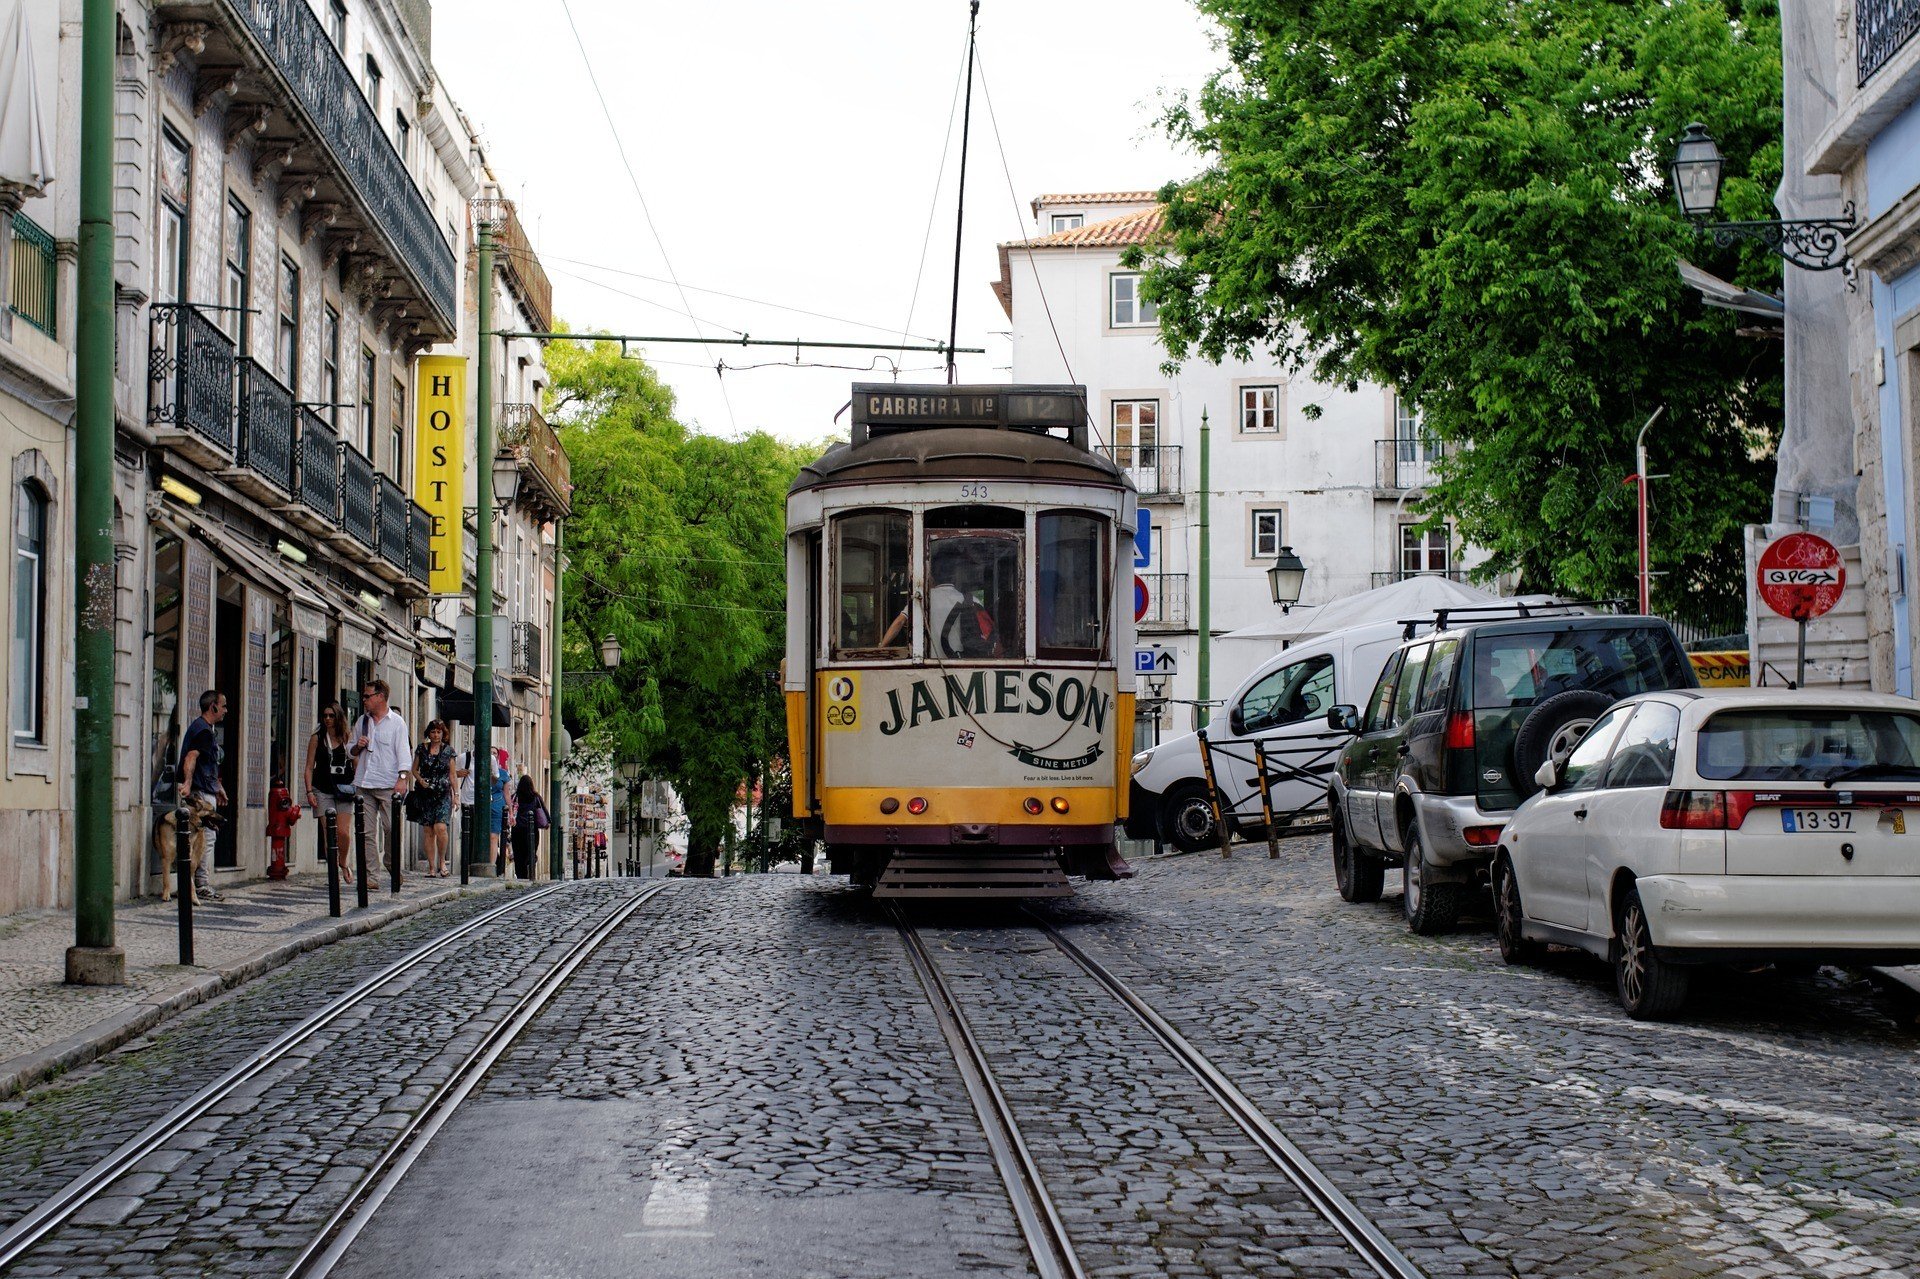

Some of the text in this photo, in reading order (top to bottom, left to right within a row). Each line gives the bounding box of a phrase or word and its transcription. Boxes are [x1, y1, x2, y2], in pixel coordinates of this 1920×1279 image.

[869, 397, 961, 415] CARREIRA
[1026, 396, 1058, 418] 12
[429, 375, 451, 572] HOSTEL
[961, 485, 988, 498] 543
[1138, 652, 1151, 669] P
[879, 670, 1109, 736] JAMESON
[1032, 757, 1088, 769] SINE METU
